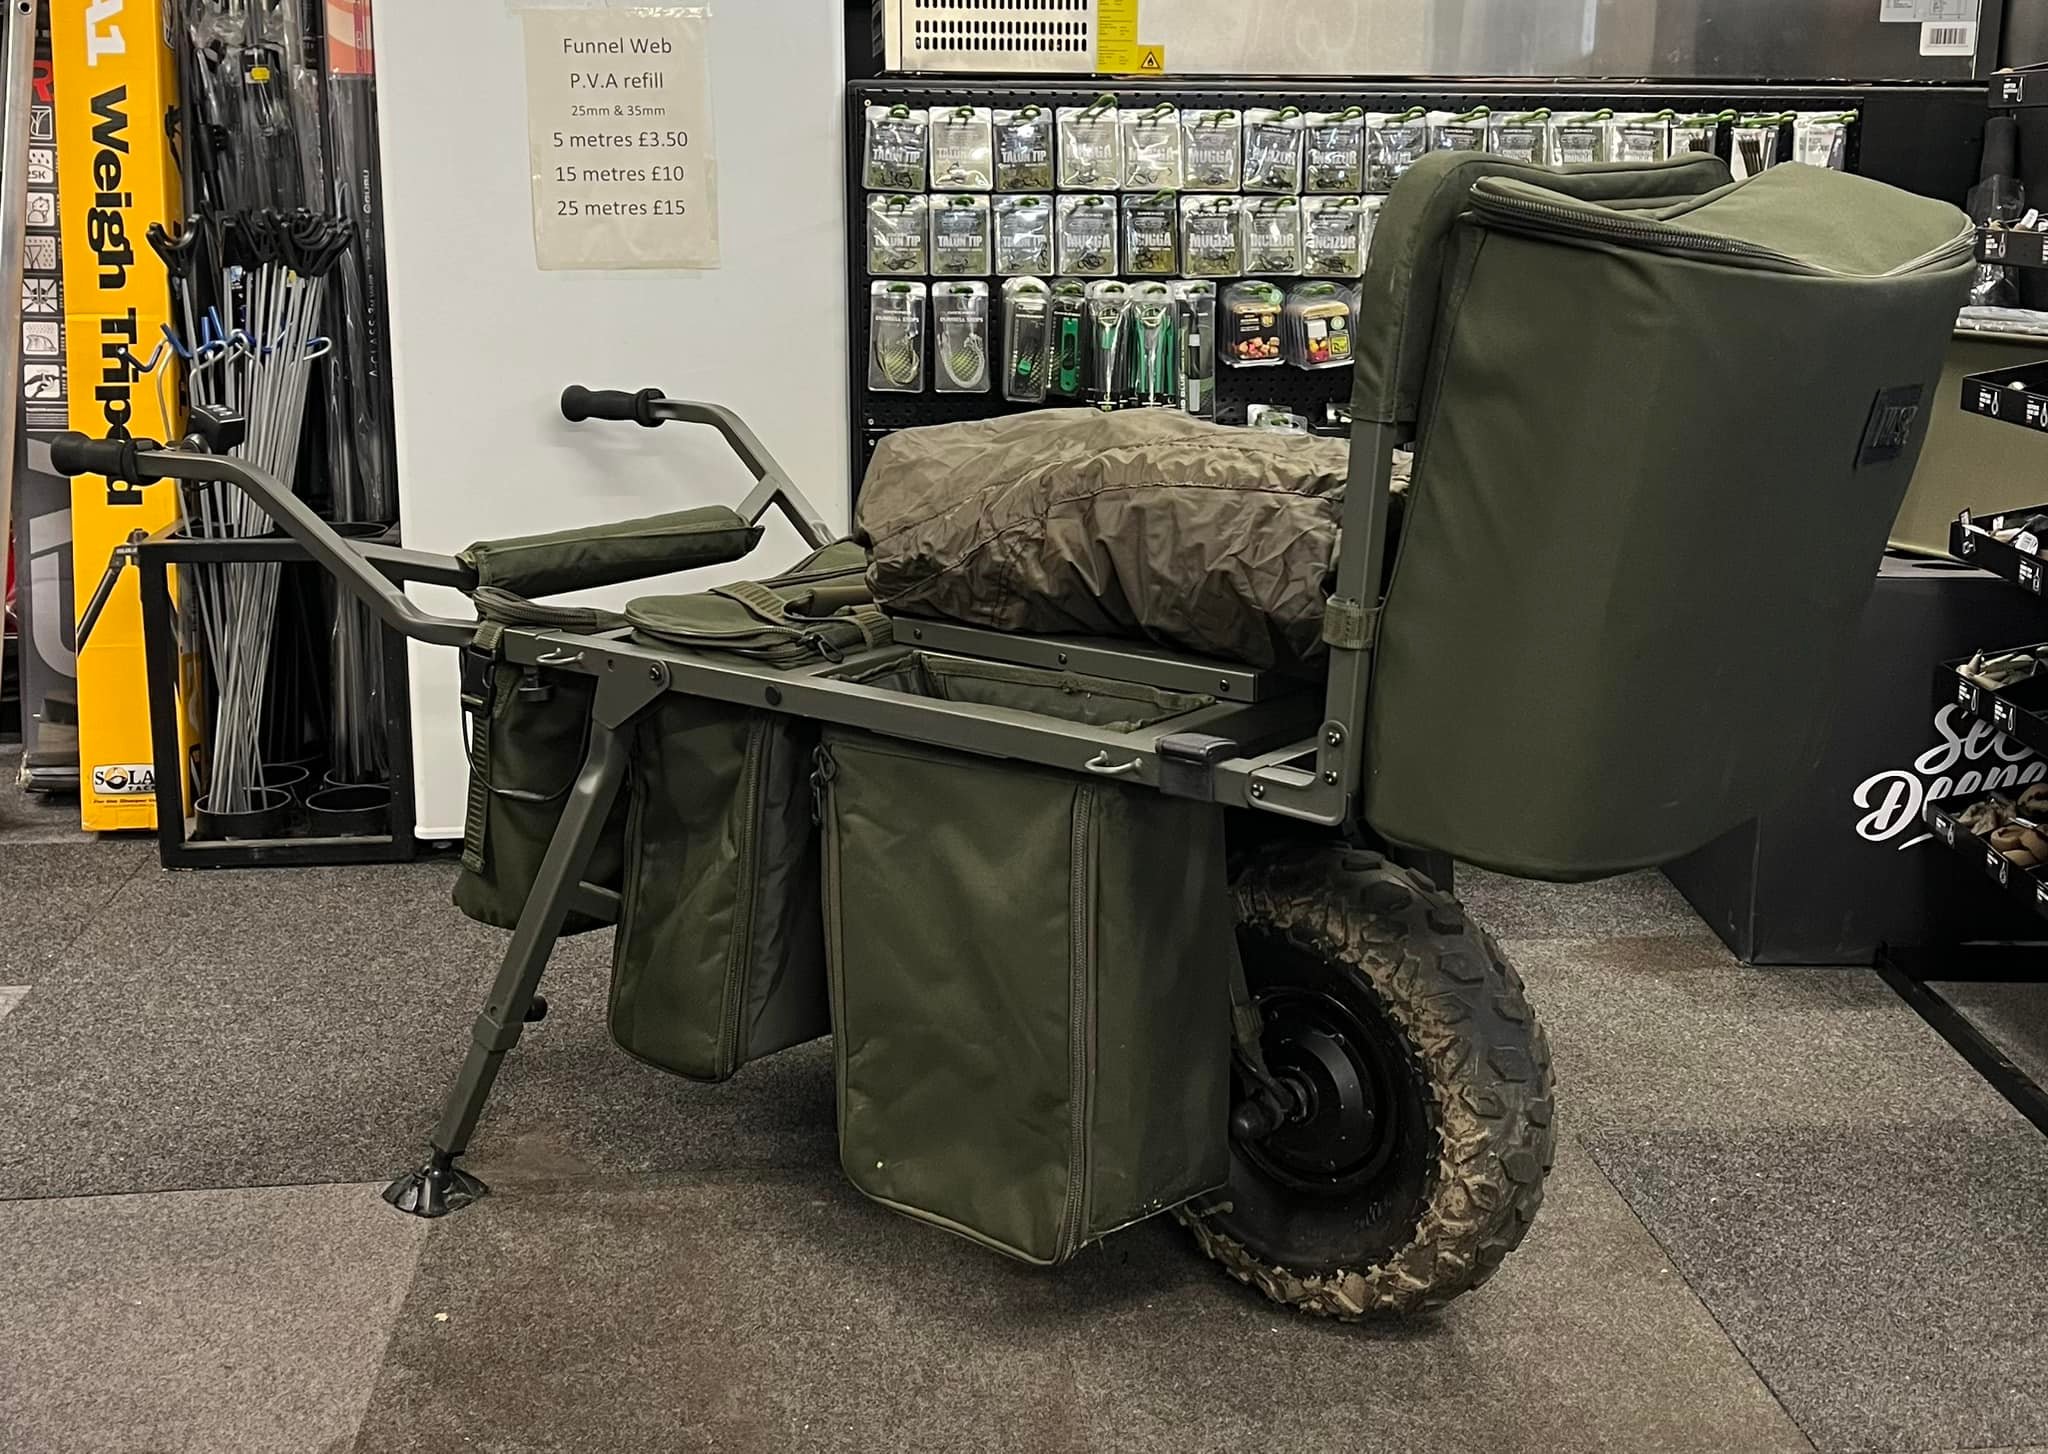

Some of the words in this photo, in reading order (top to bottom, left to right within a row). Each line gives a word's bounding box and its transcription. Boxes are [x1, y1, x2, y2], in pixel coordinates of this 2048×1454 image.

[563, 36, 624, 54] Funnel
[629, 36, 672, 54] Web
[570, 72, 619, 89] P.V.A
[623, 71, 664, 89] refill
[571, 105, 610, 117] 25mm
[613, 104, 624, 117] &
[627, 105, 666, 117] 35mm
[553, 131, 564, 148] 5
[569, 133, 633, 148] metres
[638, 131, 688, 148] £3.50
[555, 166, 577, 182] 15
[583, 167, 646, 182] metres
[651, 165, 684, 182] £10
[87, 84, 135, 290] Weigh
[557, 200, 579, 216] 25
[584, 201, 648, 216] metres
[653, 199, 686, 216] £15
